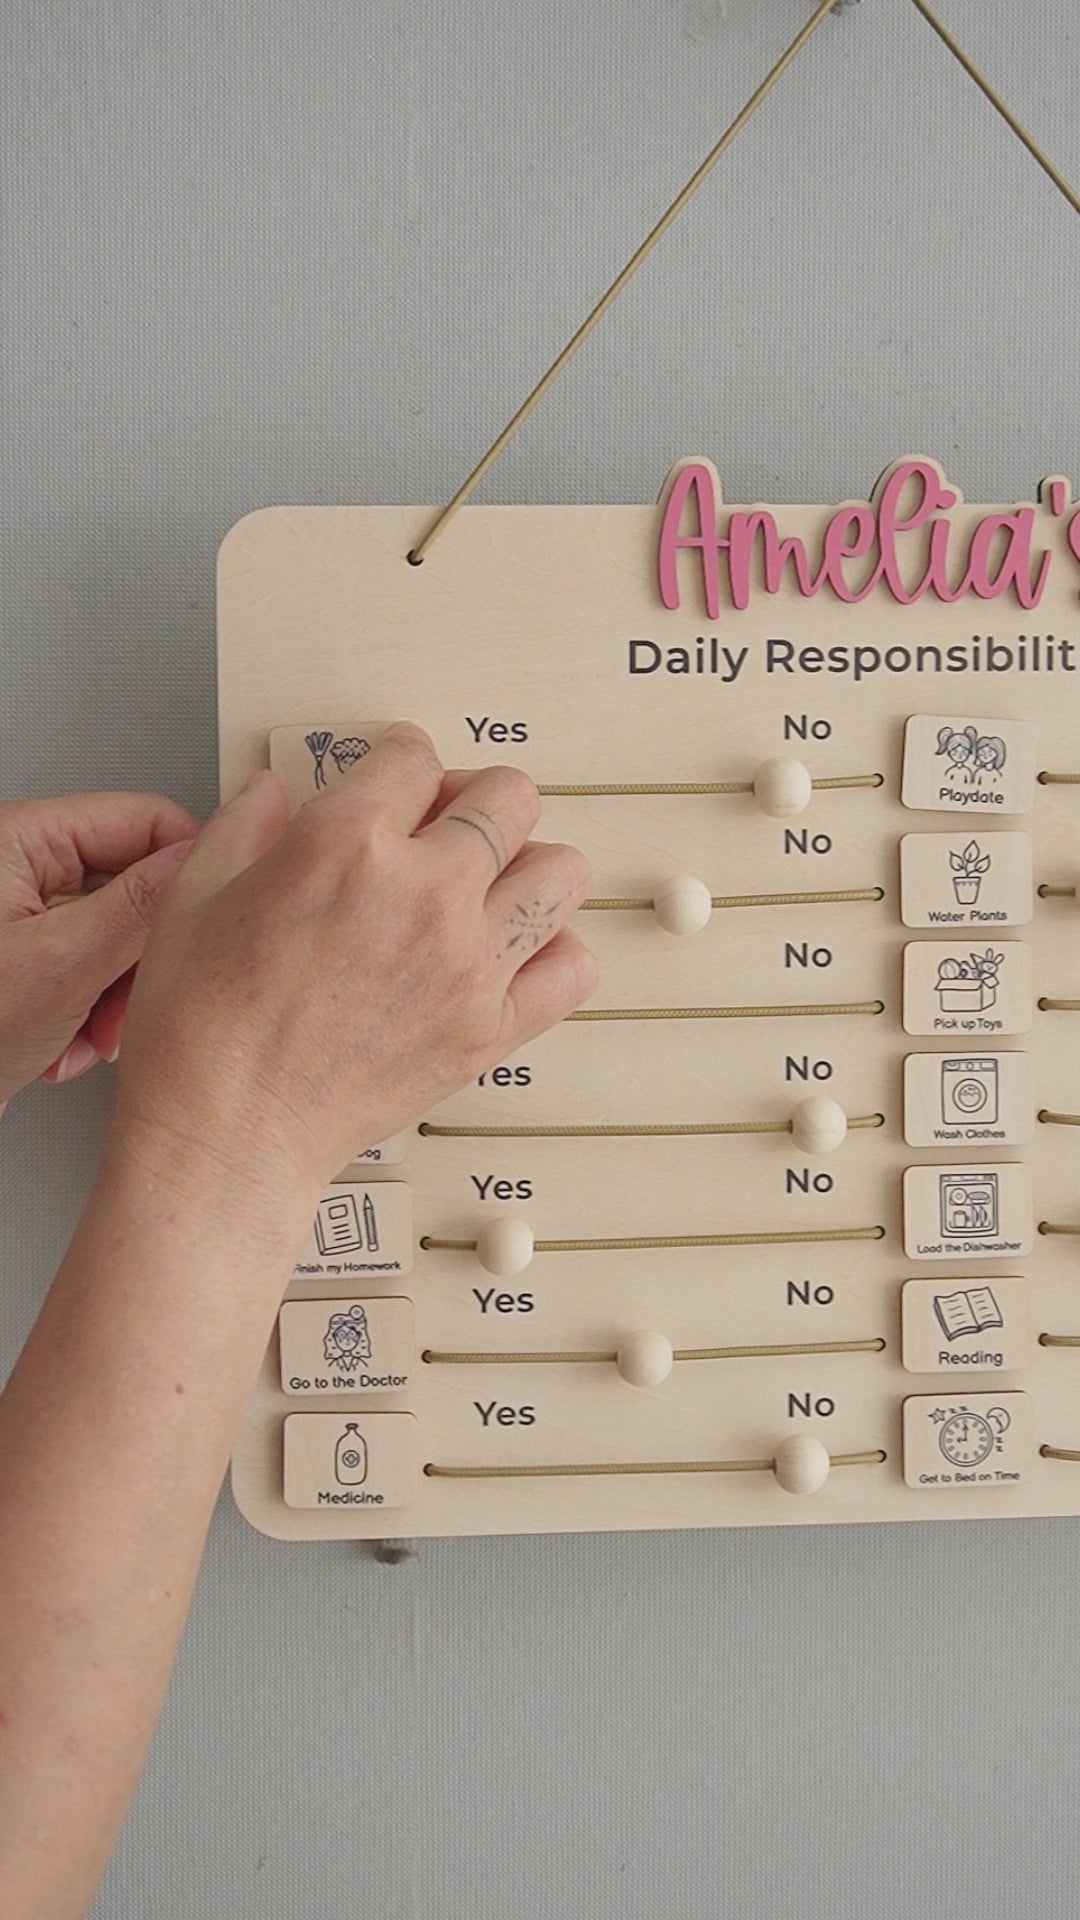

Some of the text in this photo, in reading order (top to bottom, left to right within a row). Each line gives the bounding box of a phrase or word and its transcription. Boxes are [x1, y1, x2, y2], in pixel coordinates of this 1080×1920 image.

[659, 462, 1080, 620] Amelia'
[629, 635, 1075, 682] Daily Responsibilit
[464, 716, 529, 743] Yes
[784, 714, 832, 740] No
[939, 787, 1004, 805] Playdate
[784, 828, 832, 855] No
[928, 909, 1007, 923] Water Plants
[785, 942, 833, 968] No
[933, 1017, 1003, 1031] Pick up Toys
[785, 1055, 833, 1081] No
[933, 1129, 1006, 1139] Wash Clothes
[357, 1149, 381, 1161] og
[470, 1174, 533, 1201] Yes
[786, 1167, 834, 1194] No
[917, 1241, 1022, 1254] Load the Dishwasher
[326, 1264, 342, 1275] my
[343, 1261, 401, 1272] Homework
[471, 1287, 535, 1314] Yes
[787, 1280, 834, 1306] No
[938, 1350, 1003, 1367] Reading
[289, 1374, 408, 1390] Go to the Doctor
[473, 1401, 536, 1427] Yes
[788, 1392, 835, 1418] No
[919, 1470, 1021, 1484] Get to Bed on Time
[317, 1491, 384, 1505] Medicine
